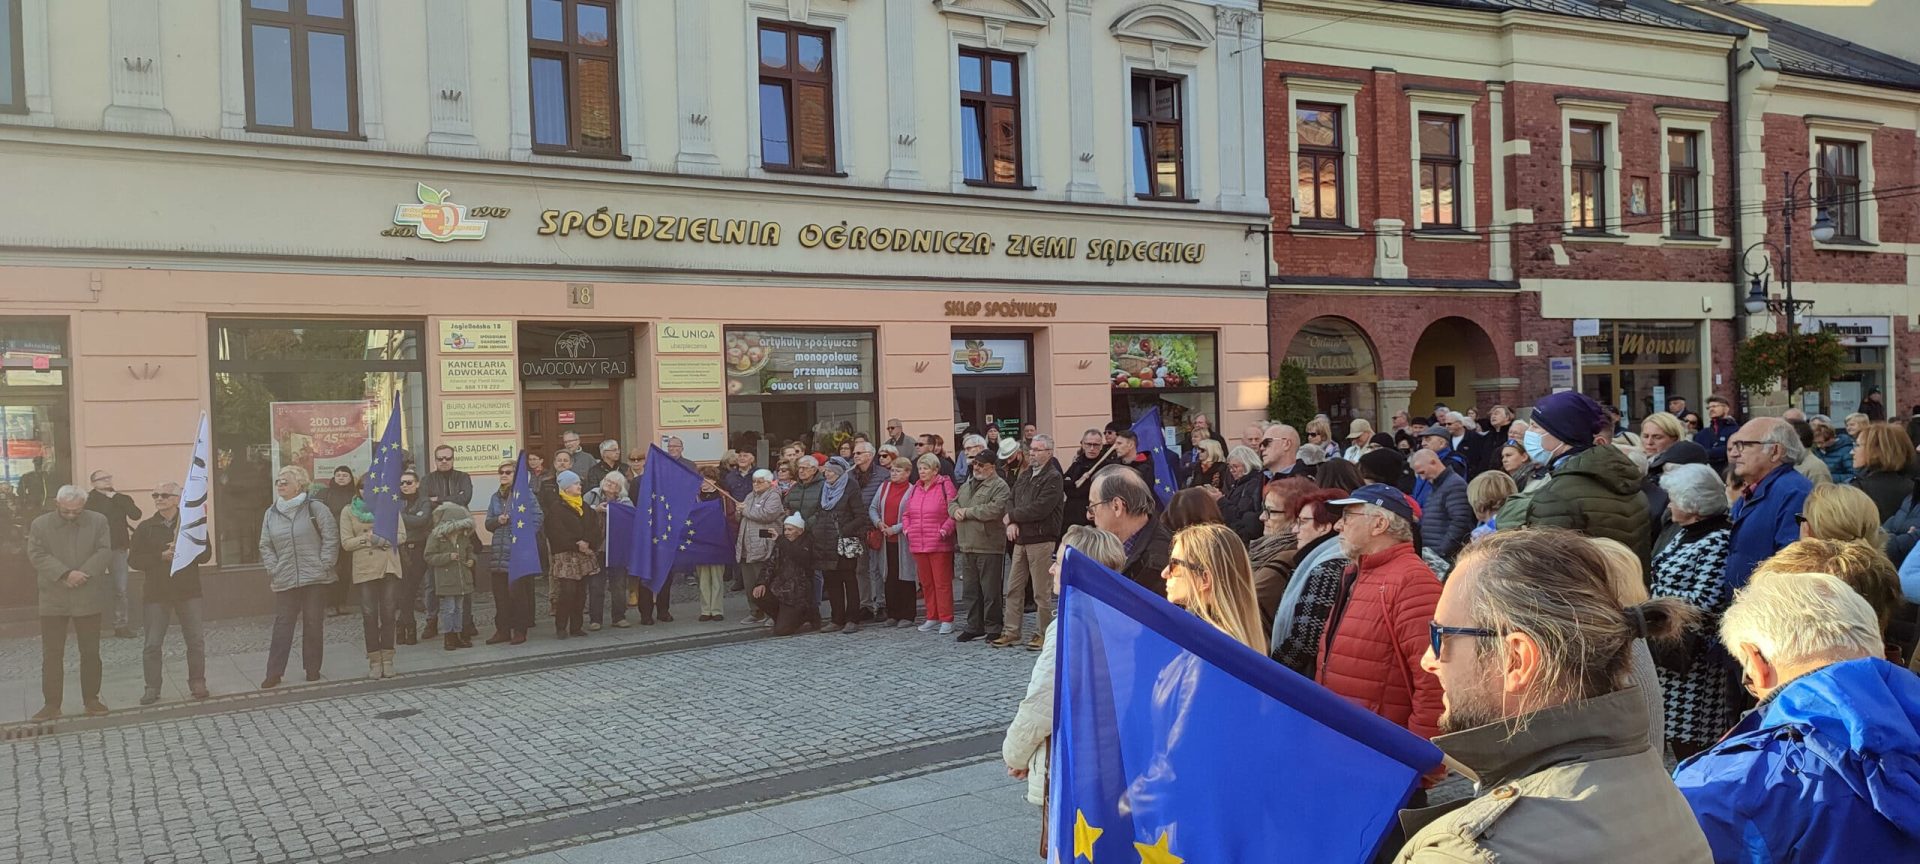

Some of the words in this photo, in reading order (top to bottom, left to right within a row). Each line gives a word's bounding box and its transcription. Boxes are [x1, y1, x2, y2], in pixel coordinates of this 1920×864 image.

[471, 205, 511, 219] 1907
[537, 206, 781, 246] SPÓŁDZIELNIA
[798, 223, 992, 255] OGRODNICZA
[1005, 234, 1077, 259] ZIEMI
[1086, 239, 1206, 266] SĄDECKIEJ
[572, 286, 590, 305] 18
[944, 300, 981, 317] SKLEP
[984, 298, 1057, 318] SPOŻYWCZY
[682, 329, 715, 339] UNIQA
[522, 361, 597, 375] OWOCOWY
[600, 361, 627, 374] RAJ
[771, 382, 804, 391] owoce
[807, 379, 811, 390] i
[814, 382, 859, 392] warzywa
[310, 417, 329, 426] 200
[332, 416, 347, 426] GB
[448, 421, 492, 429] OPTIMUM
[323, 433, 339, 443] 45
[466, 444, 499, 453] SĄDECKI
